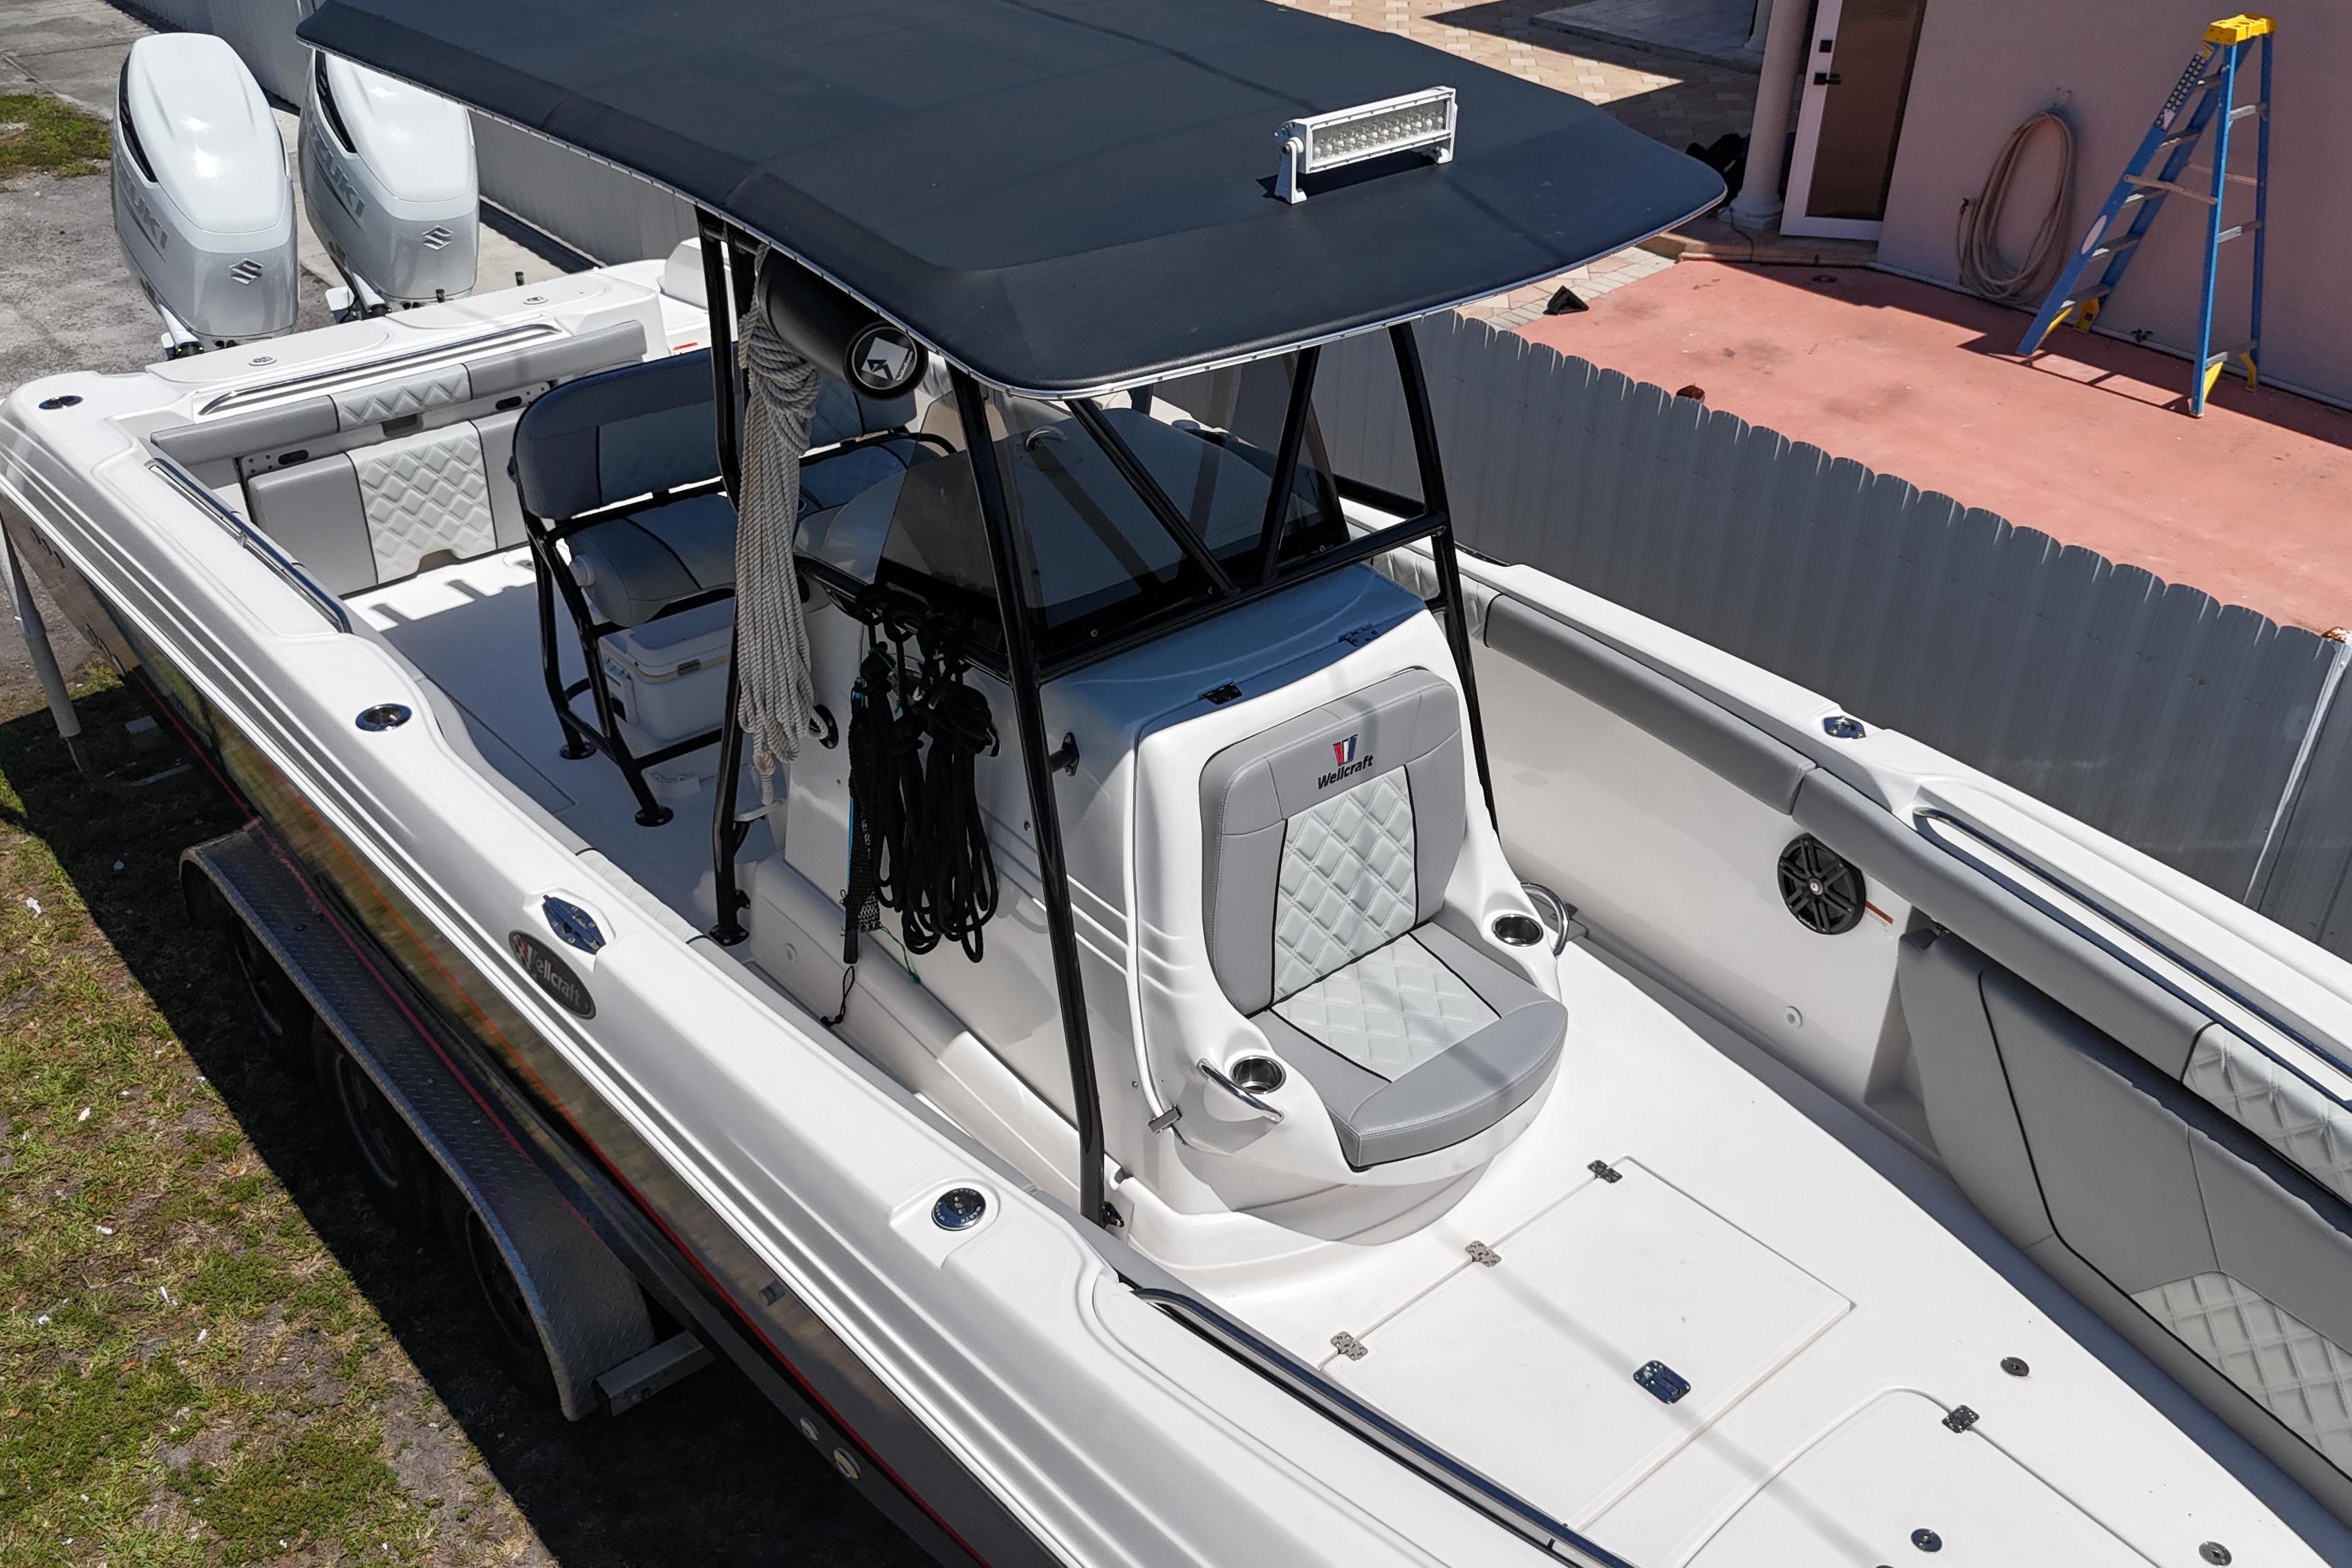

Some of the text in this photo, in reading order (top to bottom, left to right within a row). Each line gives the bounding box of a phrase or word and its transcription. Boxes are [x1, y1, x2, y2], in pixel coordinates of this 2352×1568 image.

[306, 109, 365, 218] ZUKI
[1317, 754, 1374, 790] Wellcraft
[512, 934, 581, 1005] Wellcraft
